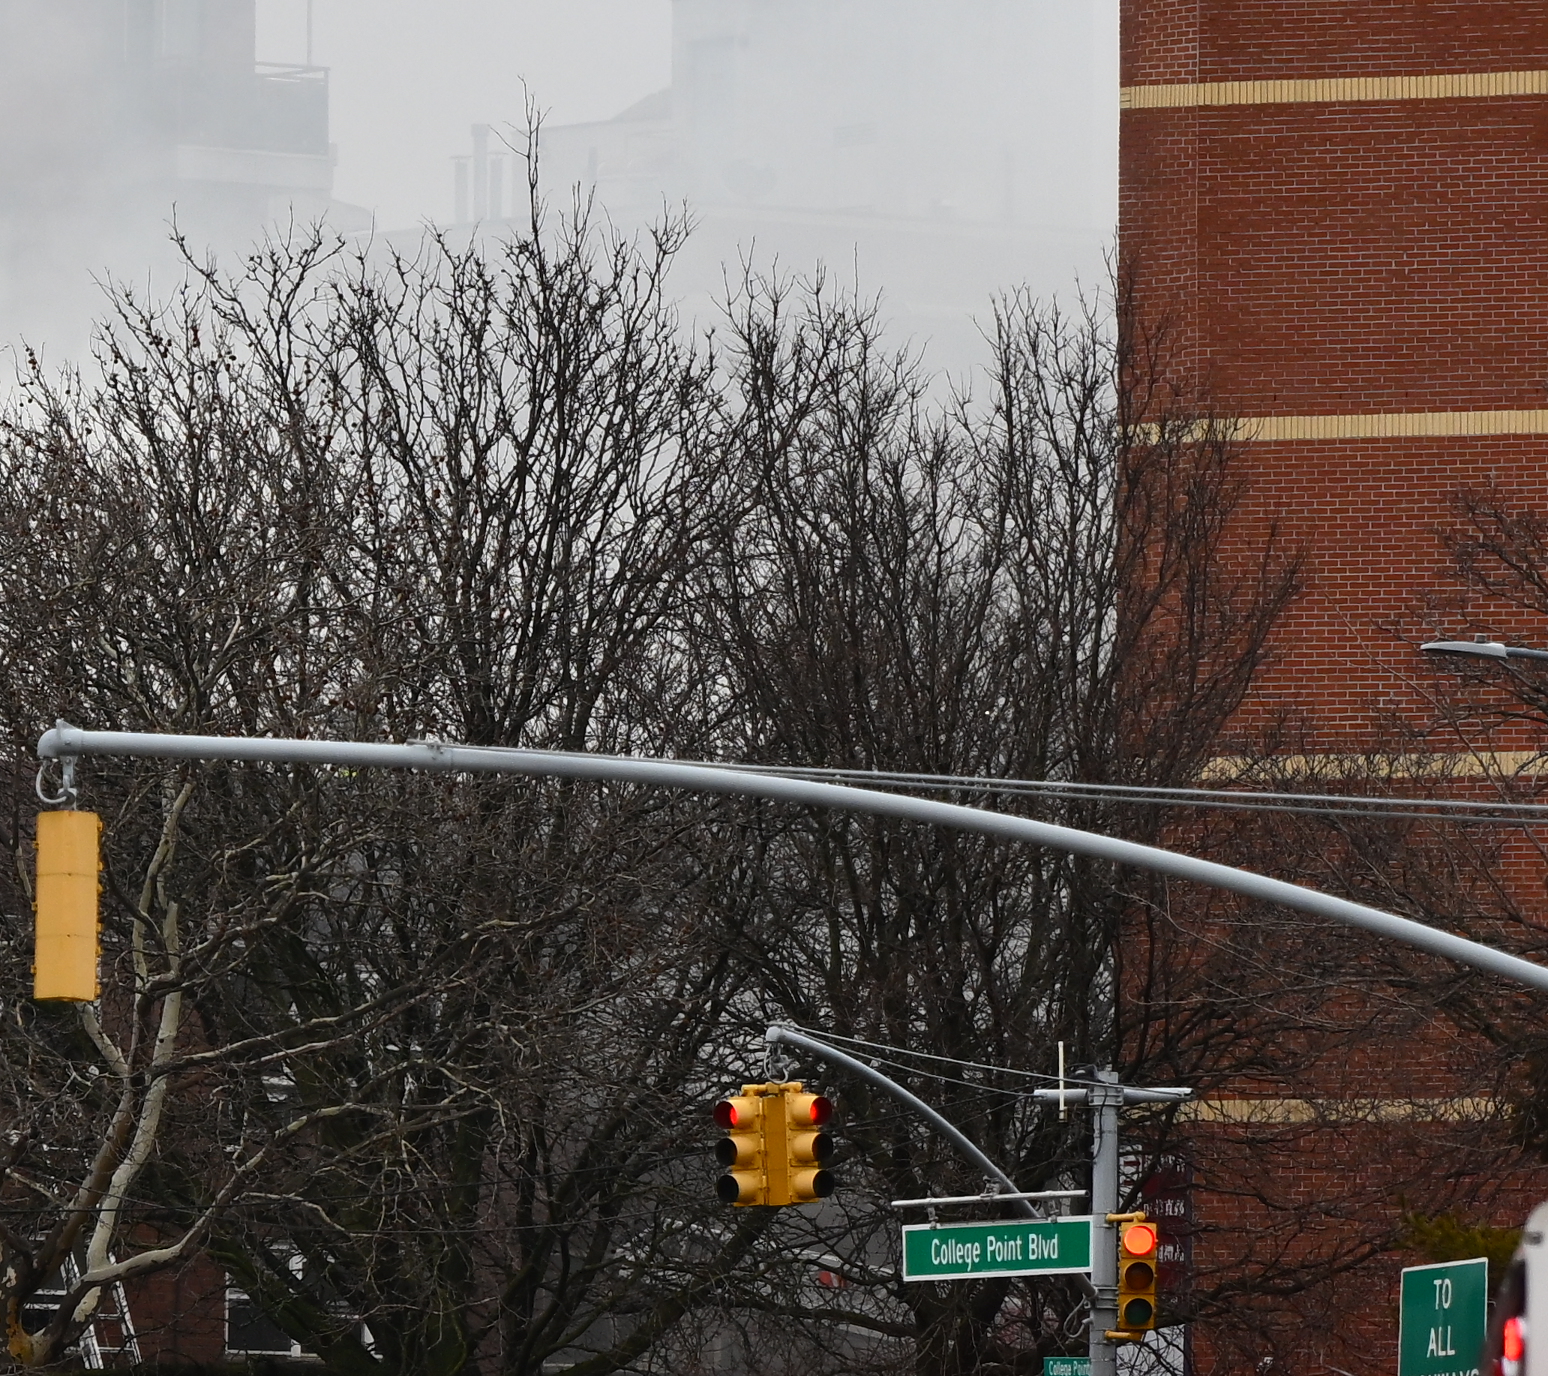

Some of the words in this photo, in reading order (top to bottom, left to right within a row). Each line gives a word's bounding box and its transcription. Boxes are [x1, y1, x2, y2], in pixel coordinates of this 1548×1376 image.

[930, 1238, 981, 1272] College
[987, 1234, 1023, 1263] Point
[1028, 1232, 1059, 1260] Blvd
[1433, 1278, 1452, 1311] TO
[1427, 1325, 1456, 1358] ALL
